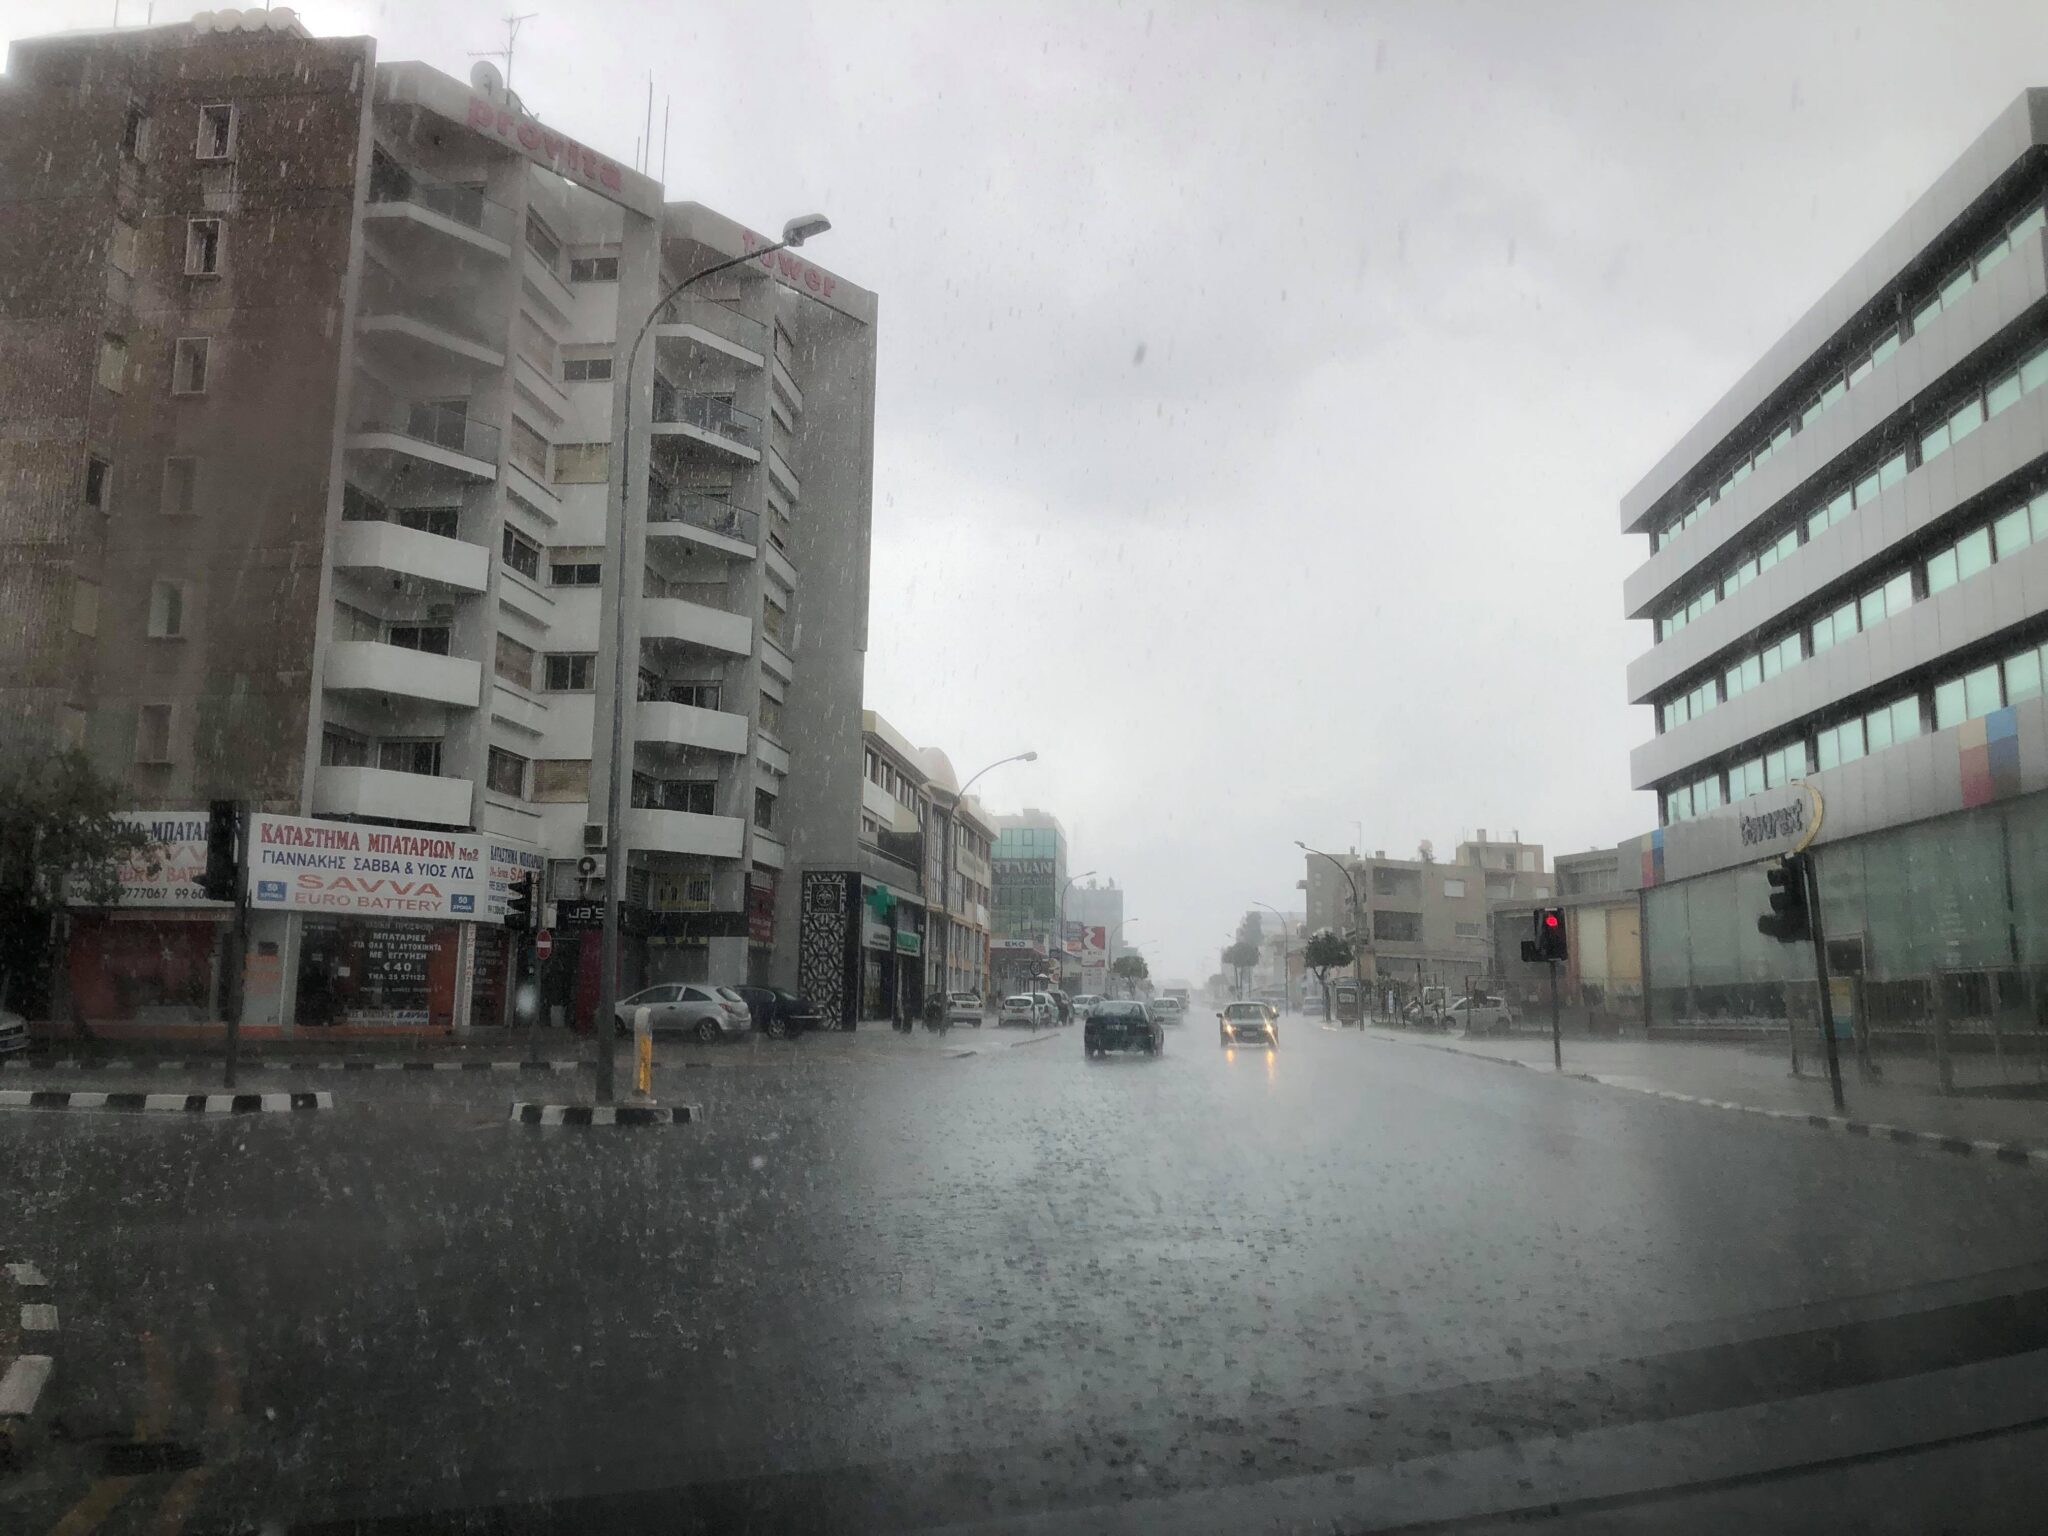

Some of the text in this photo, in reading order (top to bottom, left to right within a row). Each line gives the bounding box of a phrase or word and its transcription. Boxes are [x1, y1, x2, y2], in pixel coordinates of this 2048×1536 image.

[260, 823, 361, 852] ΚΑΤΑΣΤΗΜΑ
[368, 833, 456, 860] ΜΠΑΤΑΡΙΩΝ
[262, 850, 346, 869] ΓΙΑΝΝΑΚΗΣ
[353, 857, 400, 874] ΣΑΒΒΑ
[404, 862, 413, 875] &
[417, 862, 447, 878] ΥΙΟΣ
[451, 866, 475, 880] ΛΤΔ
[296, 873, 443, 898] SAVVA
[295, 892, 443, 912] EURO BATTERY
[373, 932, 426, 942] ΜΠΑΤΑΡΙΕΣ
